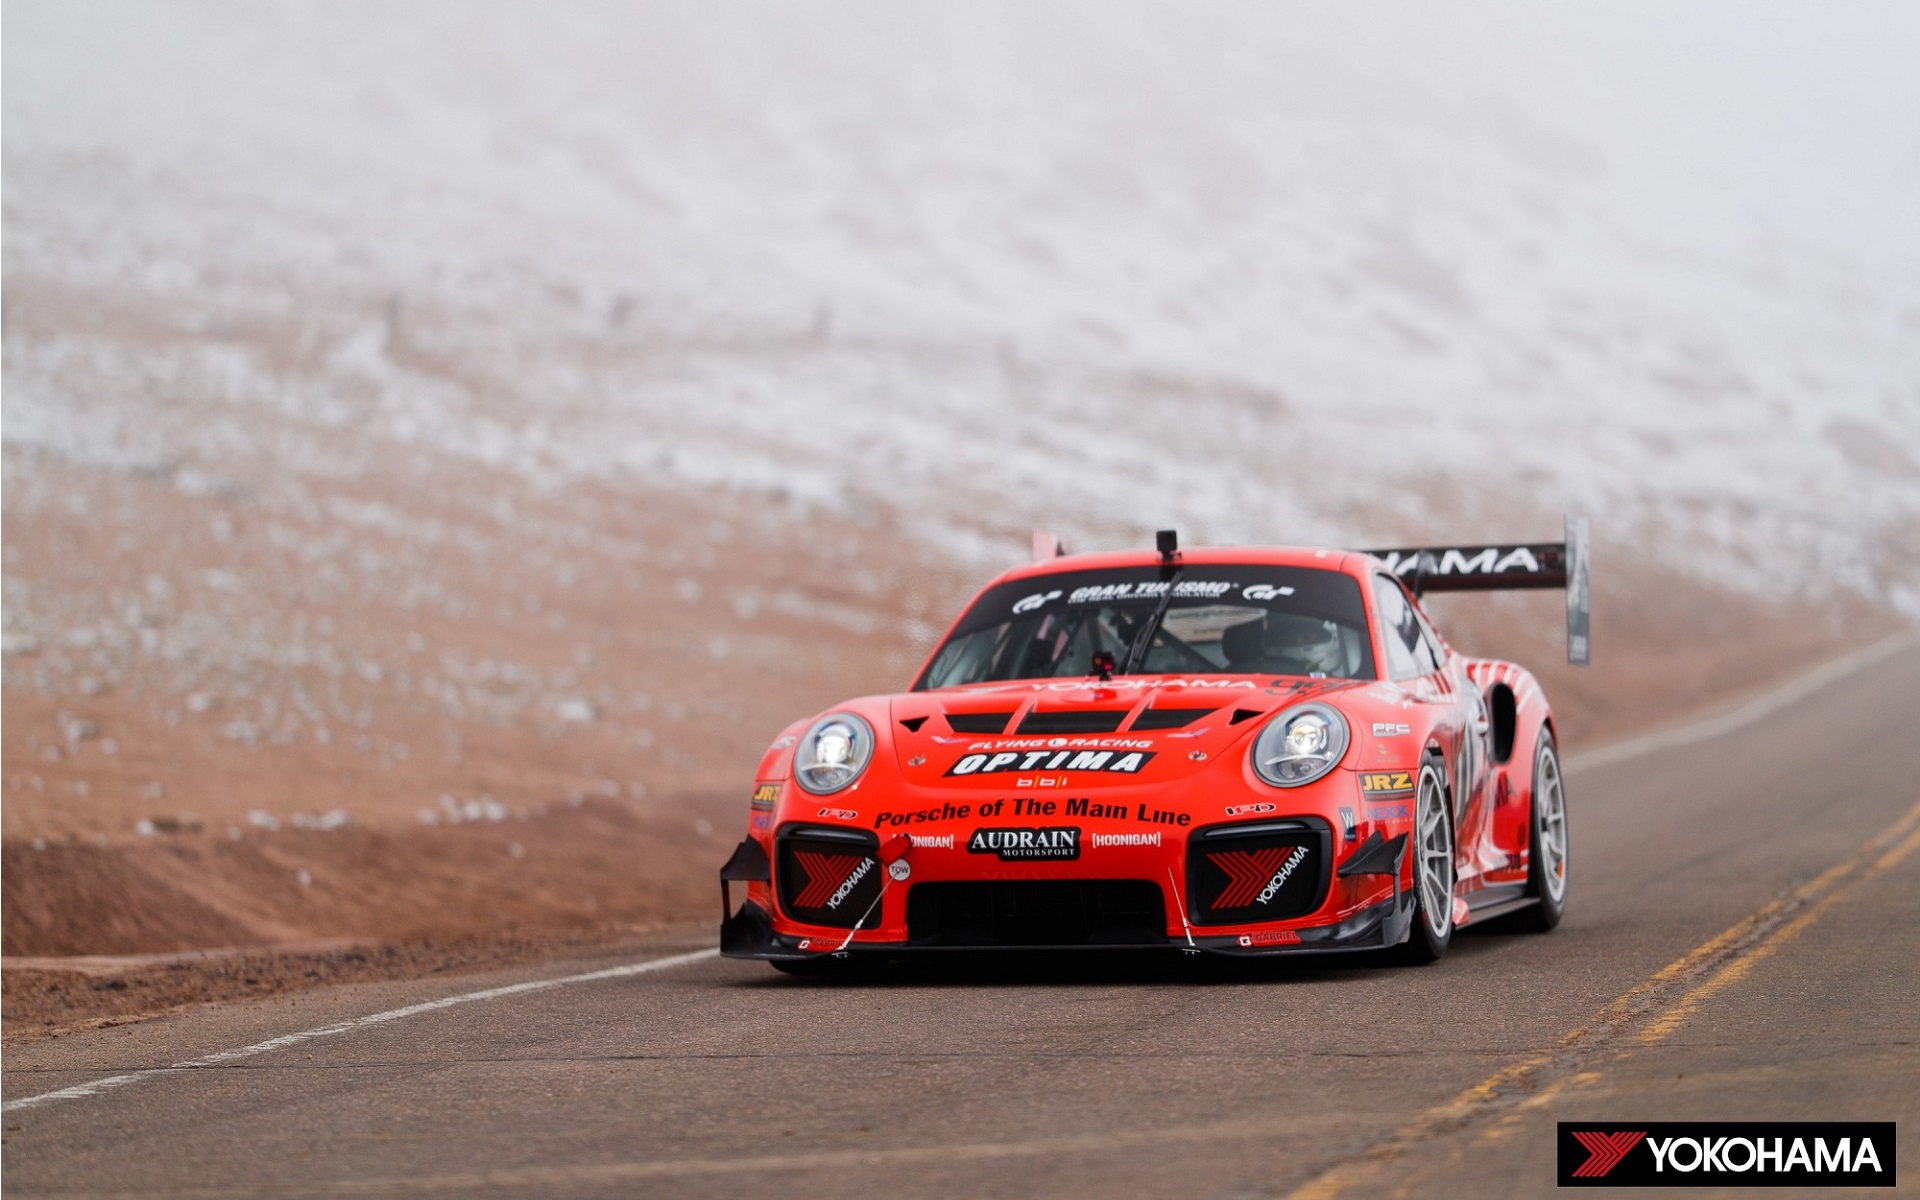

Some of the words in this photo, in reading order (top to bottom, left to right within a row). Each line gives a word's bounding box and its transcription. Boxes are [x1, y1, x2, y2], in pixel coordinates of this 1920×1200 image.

[1069, 583, 1132, 600] GRAN
[1031, 679, 1257, 691] YOKOHAMA
[968, 738, 1048, 750] FLYING
[1067, 738, 1154, 748] RACING
[952, 750, 1144, 775] OPTIMA
[1363, 773, 1413, 791] JRZ
[874, 802, 971, 829] Porsche
[978, 799, 1005, 817] of
[1012, 798, 1057, 816] The
[1065, 798, 1128, 820] Main
[1137, 803, 1192, 827] Line
[971, 830, 1076, 849] AUDRAIN
[1092, 831, 1161, 848] [HOONIGAN]
[1002, 848, 1075, 857] MOTORSPORT
[890, 865, 909, 874] TOW
[1256, 845, 1310, 905] YOKOHAMA
[826, 856, 876, 910] YOKOHAMA
[813, 938, 842, 948] GABRIE
[1255, 931, 1299, 941] GABRIEL
